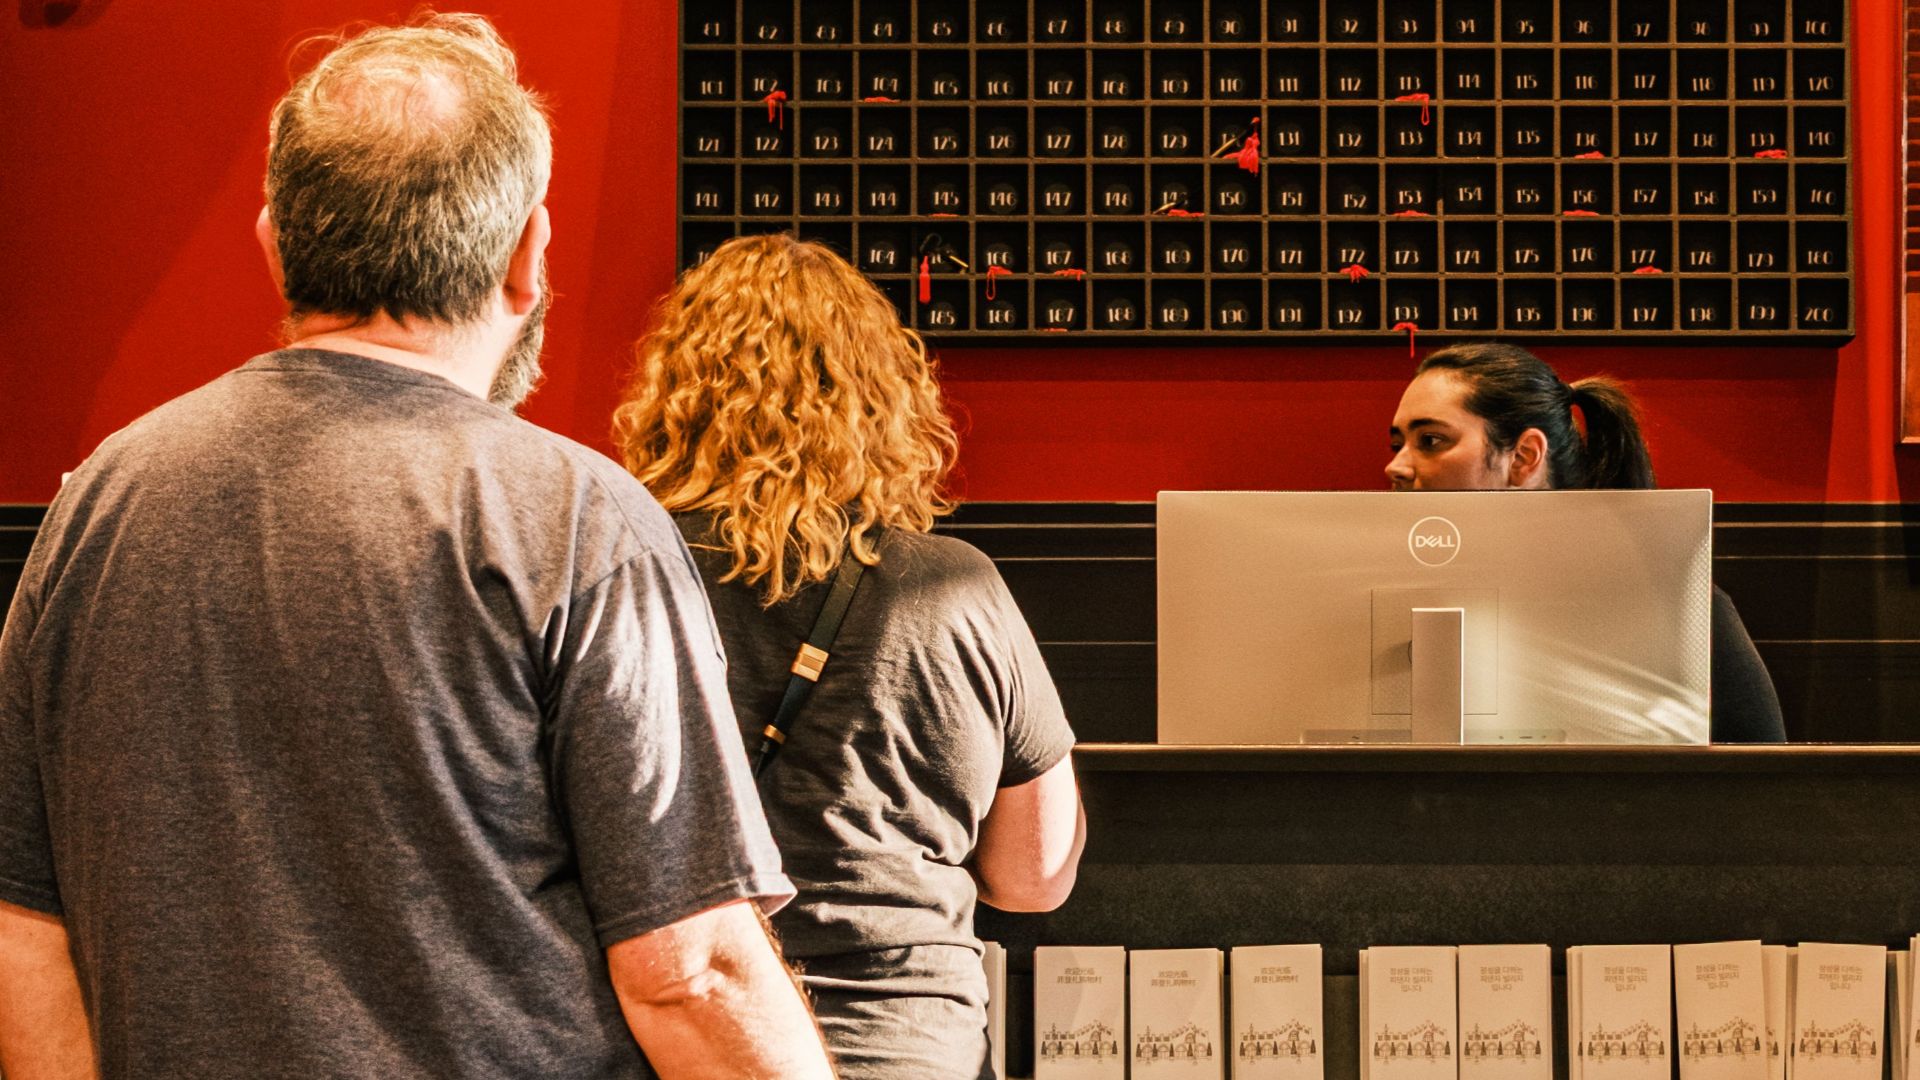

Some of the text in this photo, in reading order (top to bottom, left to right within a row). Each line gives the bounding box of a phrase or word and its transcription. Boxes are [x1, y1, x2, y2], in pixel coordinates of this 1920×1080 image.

[703, 22, 720, 37] 81
[758, 25, 778, 40] 82
[816, 25, 836, 40] 83
[872, 22, 893, 37] 84
[932, 22, 952, 36] 85
[987, 22, 1006, 36] 86
[1047, 19, 1068, 35] 87
[1104, 20, 1125, 35] 88
[1164, 20, 1185, 35] 89
[1220, 20, 1240, 35] 90
[1281, 18, 1298, 33] 91
[1339, 18, 1359, 34] 92
[1398, 19, 1418, 34] 93
[1456, 18, 1475, 34] 94
[1516, 20, 1535, 34] 95
[1574, 19, 1592, 34] 96
[1632, 23, 1651, 37] 97
[1691, 21, 1710, 36] 98
[1750, 22, 1770, 36] 99
[1805, 20, 1830, 35] 100
[701, 80, 723, 95] 101
[753, 77, 778, 92] 102
[816, 78, 842, 94] 103
[873, 76, 898, 93] 104
[933, 80, 959, 97] 105
[987, 80, 1012, 97] 106
[1047, 80, 1074, 95] 107
[1102, 80, 1127, 95] 108
[1162, 79, 1189, 94] 109
[1219, 77, 1243, 93] 110
[1279, 77, 1299, 93] 111
[1340, 76, 1362, 92] 112
[1399, 75, 1421, 91] 113
[1458, 73, 1480, 89] 114
[1516, 74, 1538, 90] 115
[1575, 75, 1596, 90] 116
[1634, 74, 1656, 89] 117
[1692, 77, 1713, 92] 118
[1752, 77, 1775, 92] 119
[1808, 76, 1832, 92] 120
[698, 136, 720, 153] 121
[755, 136, 779, 151] 122
[814, 135, 839, 151] 123
[869, 135, 893, 151] 124
[933, 135, 958, 151] 125
[989, 134, 1013, 150] 126
[1046, 134, 1072, 149] 127
[1103, 134, 1130, 149] 128
[1162, 133, 1188, 149] 129
[1278, 130, 1300, 147] 131
[1338, 132, 1362, 148] 132
[1399, 131, 1424, 146] 133
[1458, 130, 1482, 146] 134
[1517, 130, 1541, 145] 135
[1576, 132, 1599, 147] 136
[1634, 131, 1658, 147] 137
[1693, 132, 1716, 148] 138
[1751, 132, 1775, 147] 139
[1808, 131, 1833, 146] 140
[695, 192, 718, 208] 141
[754, 193, 780, 208] 142
[814, 192, 841, 207] 143
[870, 191, 897, 207] 144
[933, 190, 960, 206] 145
[989, 191, 1017, 207] 146
[1044, 191, 1072, 207] 147
[1105, 191, 1131, 207] 148
[1219, 191, 1244, 207] 150
[1281, 191, 1303, 207] 151
[1343, 193, 1367, 209] 152
[1398, 189, 1423, 205] 153
[1458, 186, 1482, 202] 154
[1516, 188, 1540, 204] 155
[1573, 189, 1596, 204] 156
[1633, 188, 1658, 204] 157
[1694, 190, 1717, 206] 158
[1752, 189, 1777, 204] 159
[1810, 188, 1835, 205] 160
[869, 248, 896, 265] 164
[985, 251, 1012, 267] 166
[1045, 250, 1072, 266] 167
[1105, 250, 1130, 266] 168
[1165, 249, 1191, 265] 169
[1222, 248, 1248, 264] 170
[1280, 249, 1303, 265] 171
[1340, 248, 1366, 264] 172
[1394, 249, 1420, 265] 173
[1455, 249, 1480, 265] 174
[1514, 248, 1540, 264] 175
[1571, 247, 1596, 263] 176
[1631, 249, 1656, 264] 177
[1690, 250, 1715, 266] 178
[1748, 252, 1774, 268] 179
[1807, 250, 1831, 265] 180
[929, 309, 956, 327] 185
[988, 309, 1014, 325] 186
[1047, 307, 1075, 324] 187
[1107, 306, 1133, 323] 188
[1162, 307, 1189, 323] 189
[1220, 308, 1247, 325] 190
[1279, 307, 1302, 323] 191
[1337, 308, 1363, 324] 192
[1394, 305, 1420, 321] 193
[1452, 306, 1478, 322] 194
[1516, 307, 1541, 323] 195
[1572, 307, 1596, 322] 196
[1633, 307, 1658, 323] 197
[1690, 307, 1715, 322] 198
[1750, 304, 1776, 321] 199
[1804, 307, 1832, 322] 200
[1415, 534, 1455, 548] DELL
